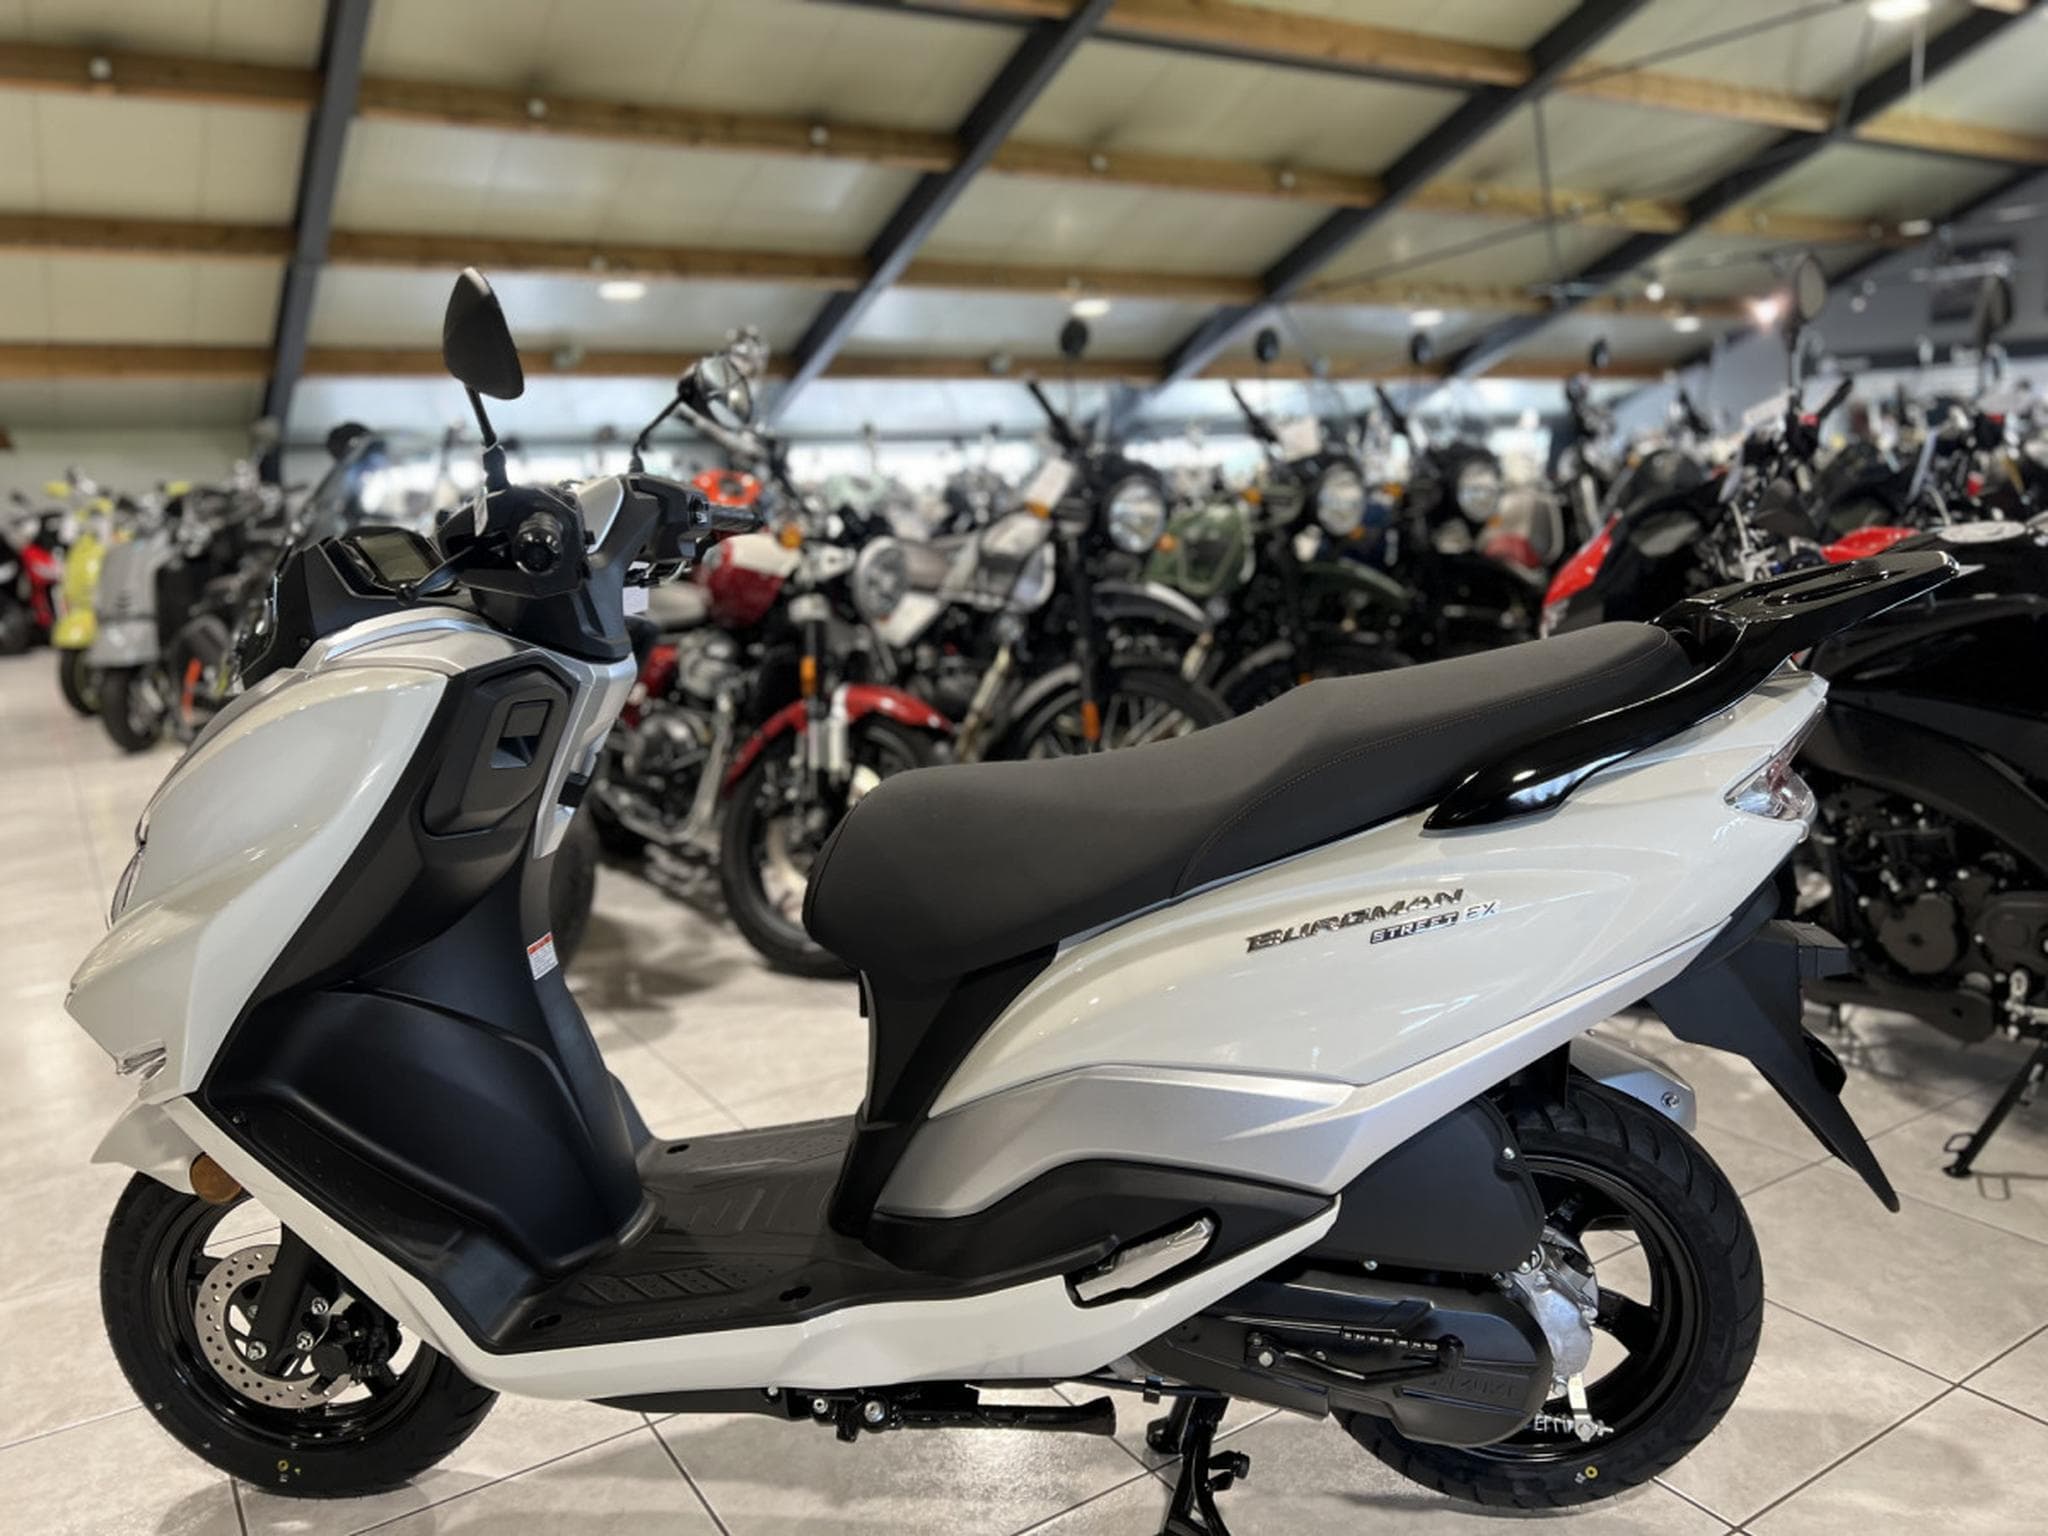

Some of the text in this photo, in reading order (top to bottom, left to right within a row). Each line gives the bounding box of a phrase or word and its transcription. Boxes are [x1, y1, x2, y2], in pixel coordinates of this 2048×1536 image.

[1247, 888, 1463, 952] BURGMAN
[1371, 901, 1498, 944] STREET EX
